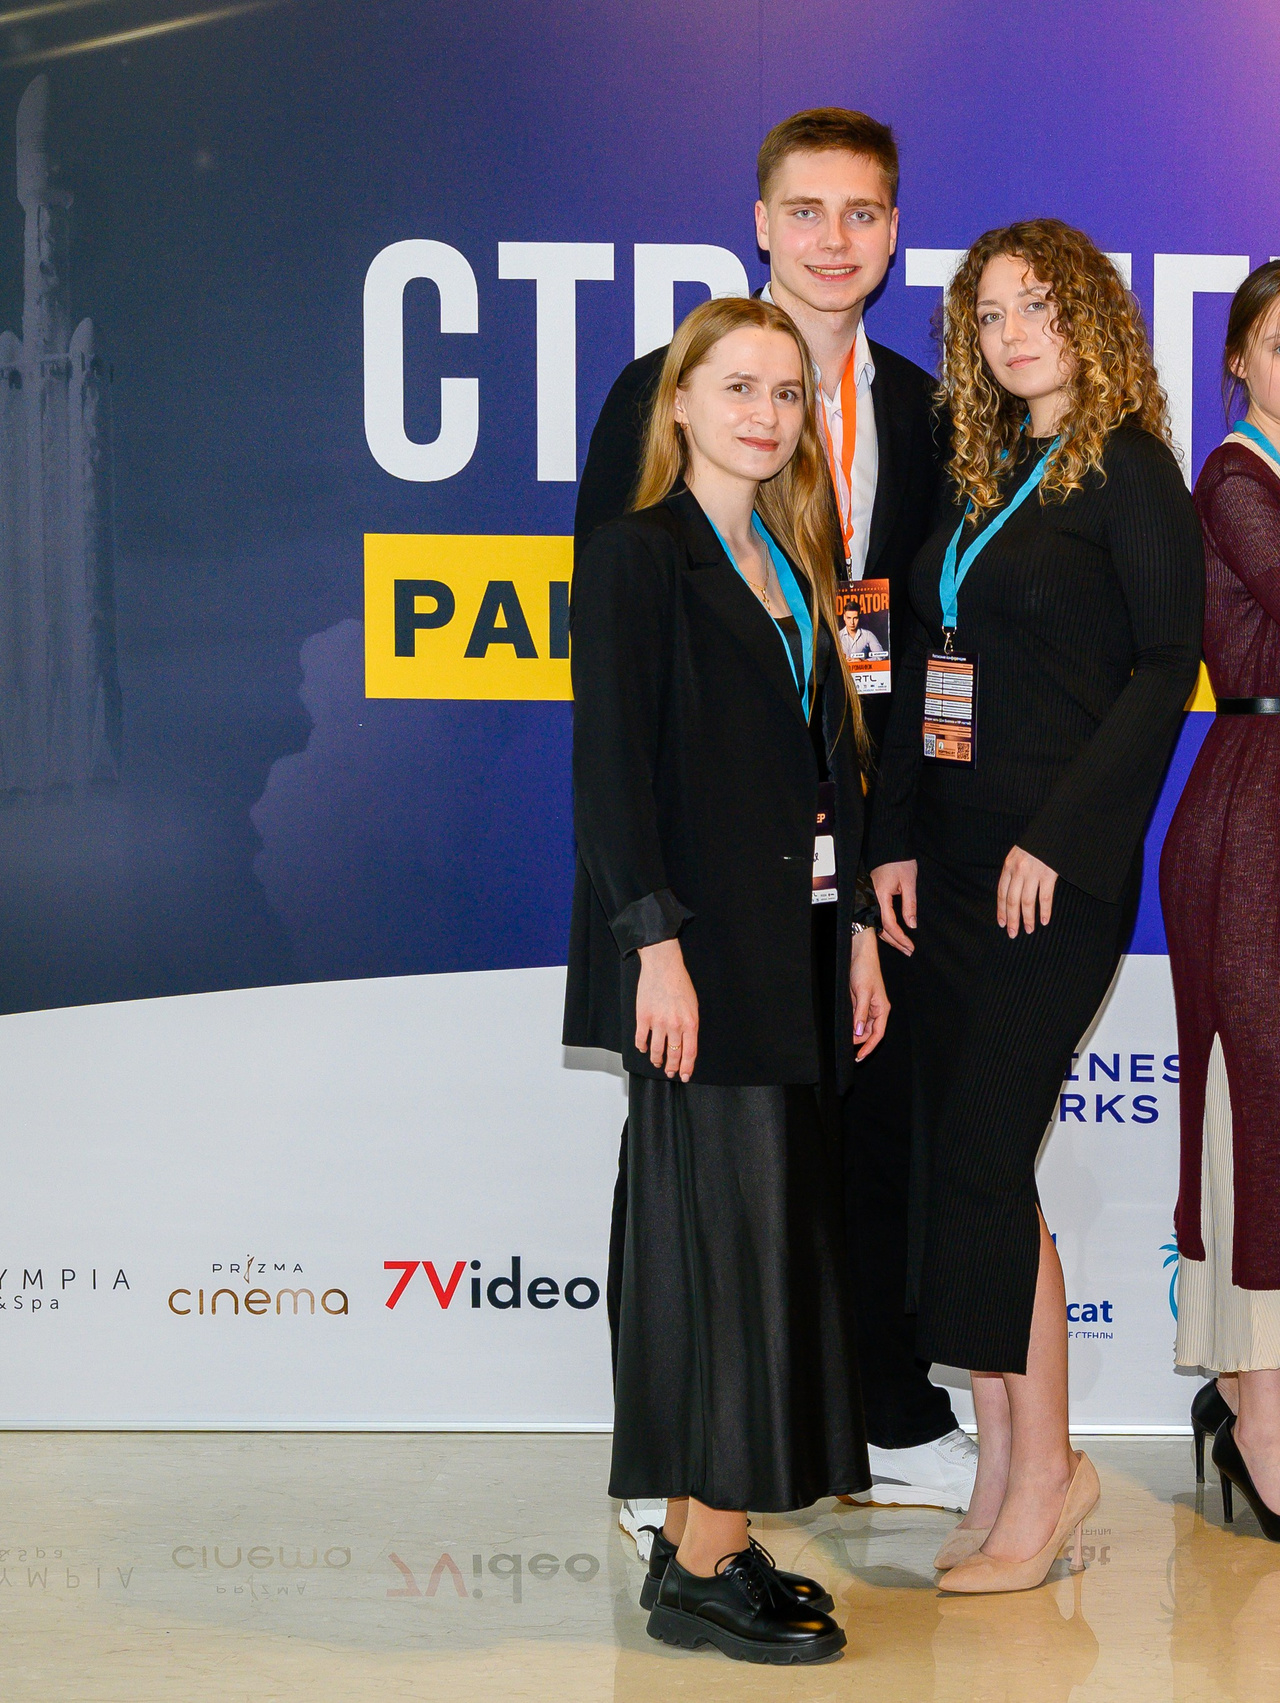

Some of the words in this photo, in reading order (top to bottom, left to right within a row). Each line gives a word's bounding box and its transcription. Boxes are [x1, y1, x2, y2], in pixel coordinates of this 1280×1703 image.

[1059, 1093, 1160, 1124] RKS
[383, 1255, 601, 1310] 7Video
[167, 1288, 349, 1316] cinema
